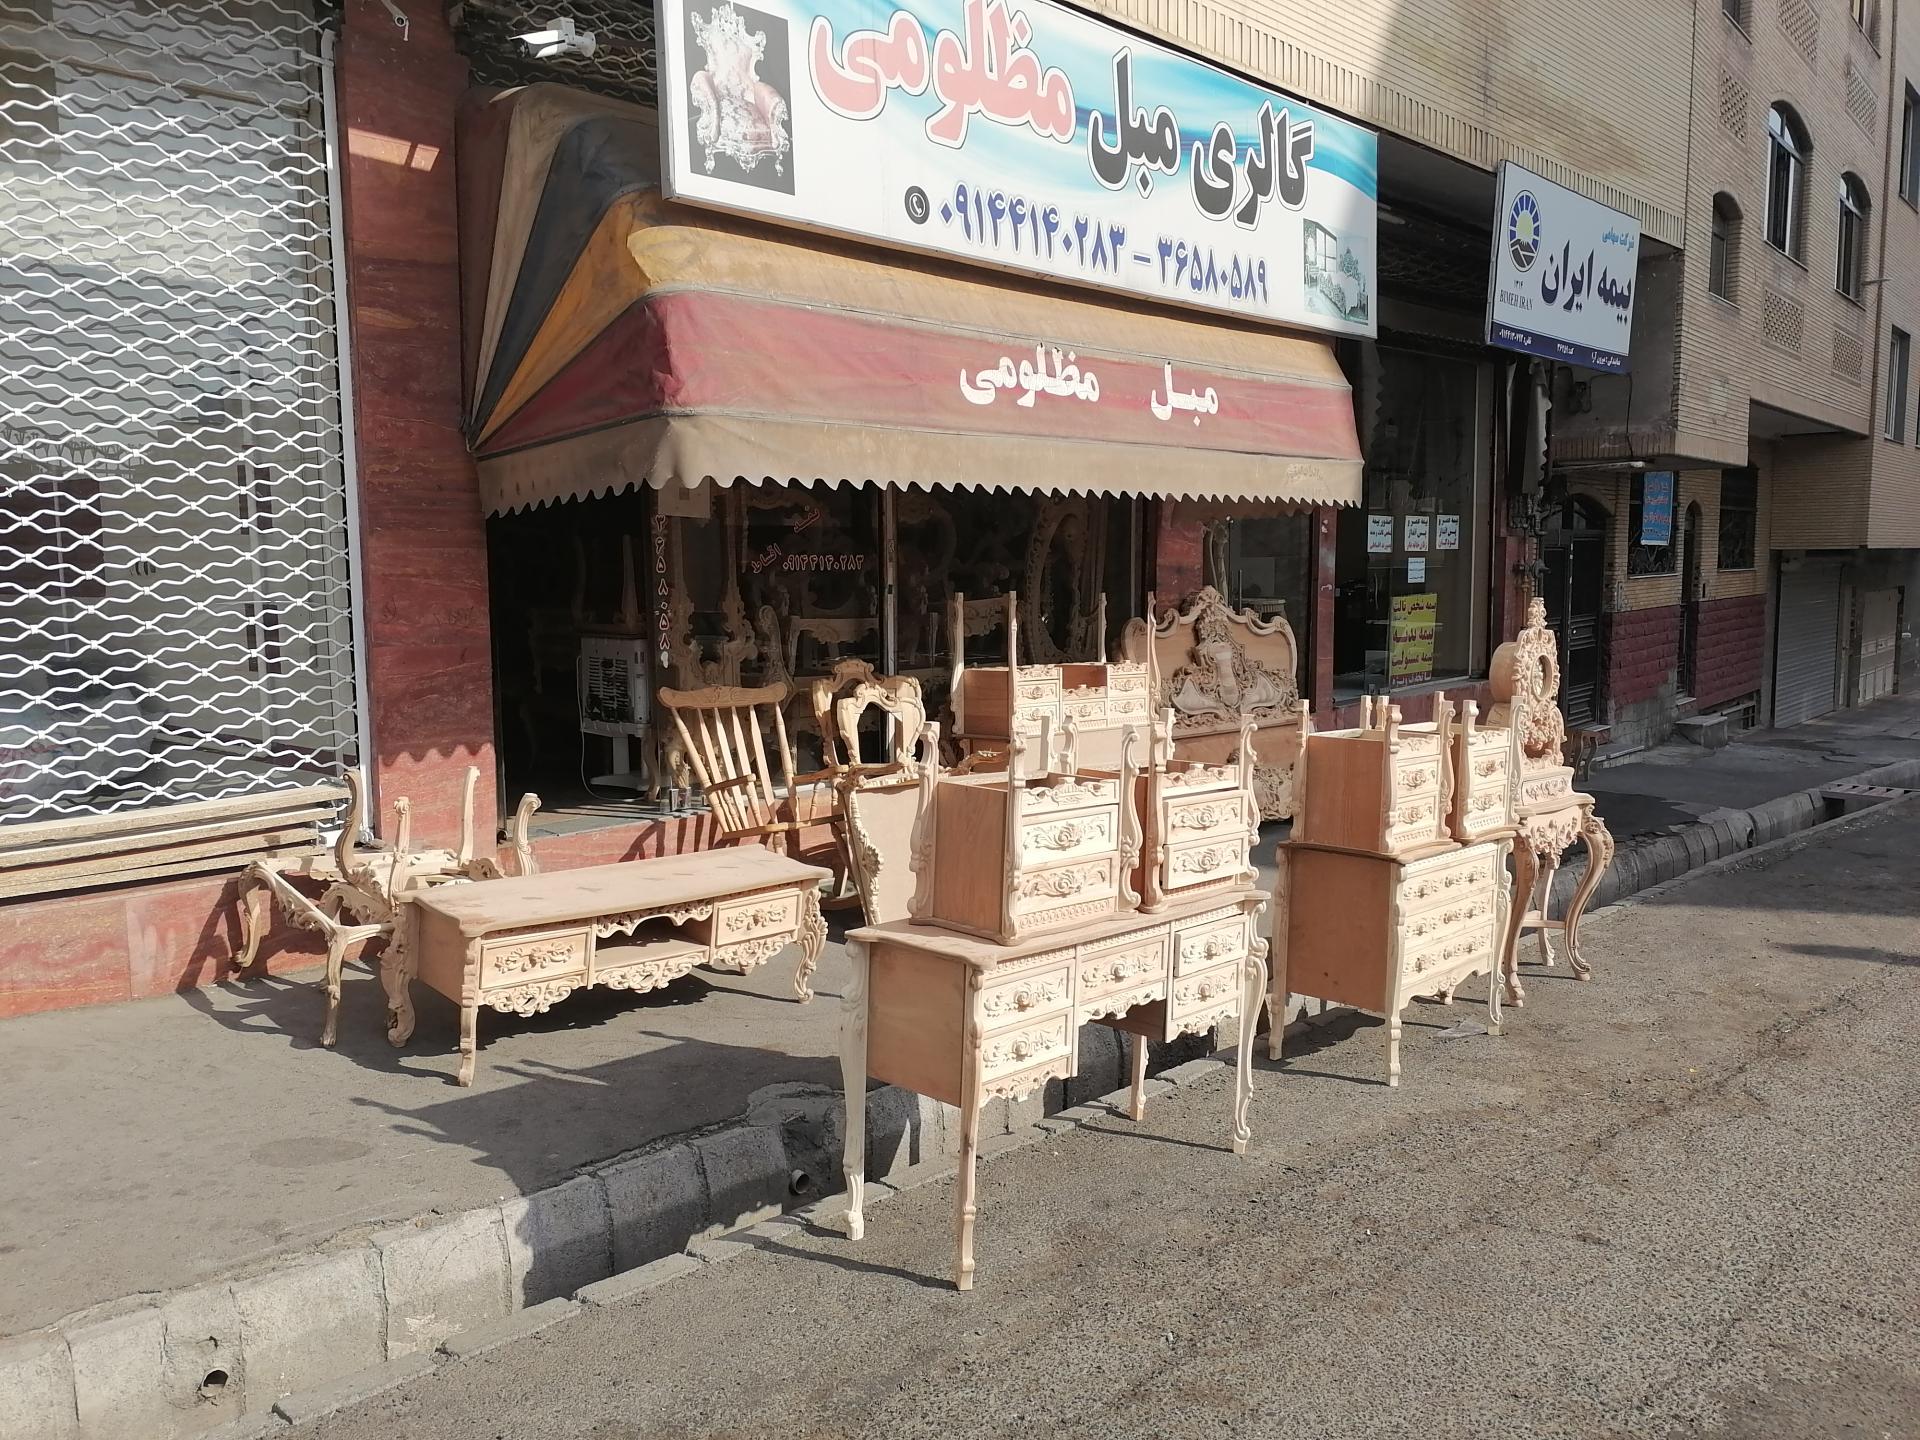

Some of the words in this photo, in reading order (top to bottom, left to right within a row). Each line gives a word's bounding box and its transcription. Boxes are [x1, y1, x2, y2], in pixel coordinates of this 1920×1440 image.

[810, 0, 1075, 147] مظلومی
[1089, 48, 1180, 198] مبل
[1193, 102, 1313, 229] گالری
[939, 183, 1126, 275] ۰۹۱۴۴۱۴۰۲۸۳
[1157, 235, 1269, 304] ۳۶۵۸۰۵۸۹
[1541, 240, 1595, 311] ایران
[1519, 295, 1534, 310] IRAN
[1597, 265, 1632, 325] بیمه
[959, 342, 1100, 407] مظلومی
[1150, 361, 1219, 426] مبل
[782, 553, 865, 571] ۰۹۱۴۴۱۴۰۲۸۳
